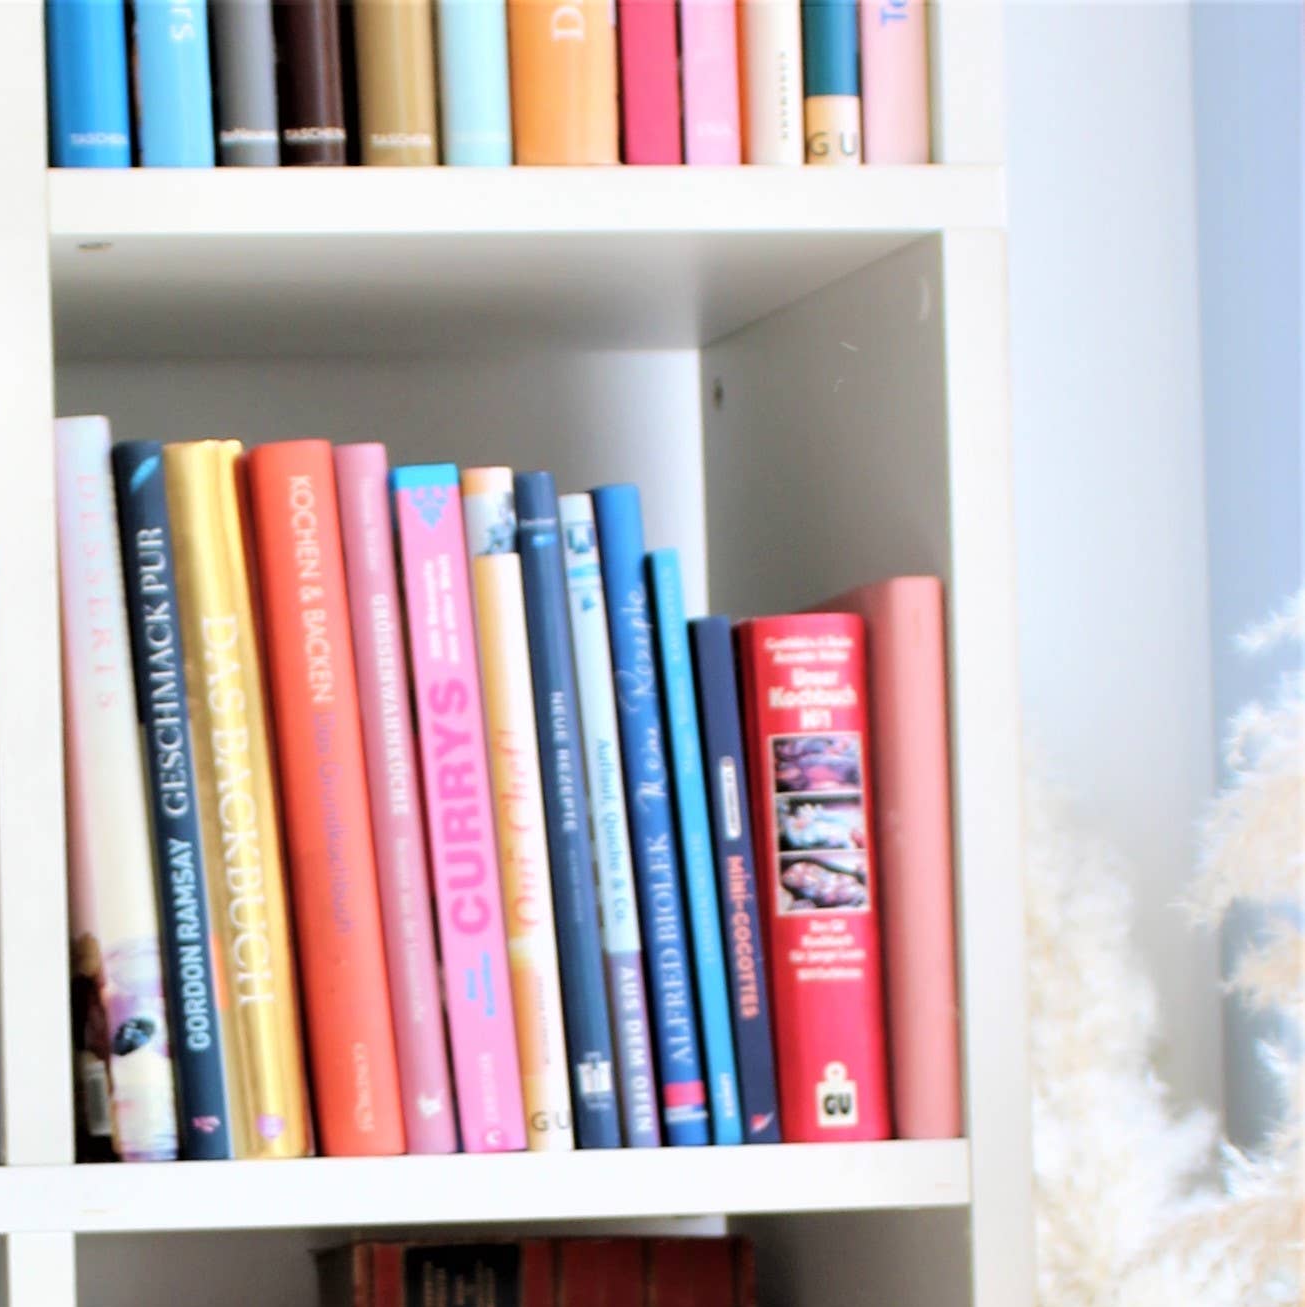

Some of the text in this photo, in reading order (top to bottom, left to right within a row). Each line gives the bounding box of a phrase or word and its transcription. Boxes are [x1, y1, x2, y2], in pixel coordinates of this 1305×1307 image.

[288, 474, 322, 580] KOCHEN
[299, 583, 325, 603] &
[298, 608, 335, 704] BACKEN
[550, 691, 571, 742] NEUE
[135, 526, 212, 1052] GORDON RAMSAY GESCHMACK PUR
[201, 613, 276, 1006] DAS BACKBUCH
[427, 678, 492, 935] CURRYS
[554, 748, 578, 833] REZEPTE
[646, 831, 680, 941] BIOLEK
[619, 966, 654, 1132] AUS DEM OFEN
[657, 947, 695, 1066] ALFRED
[822, 1091, 852, 1116] GU
